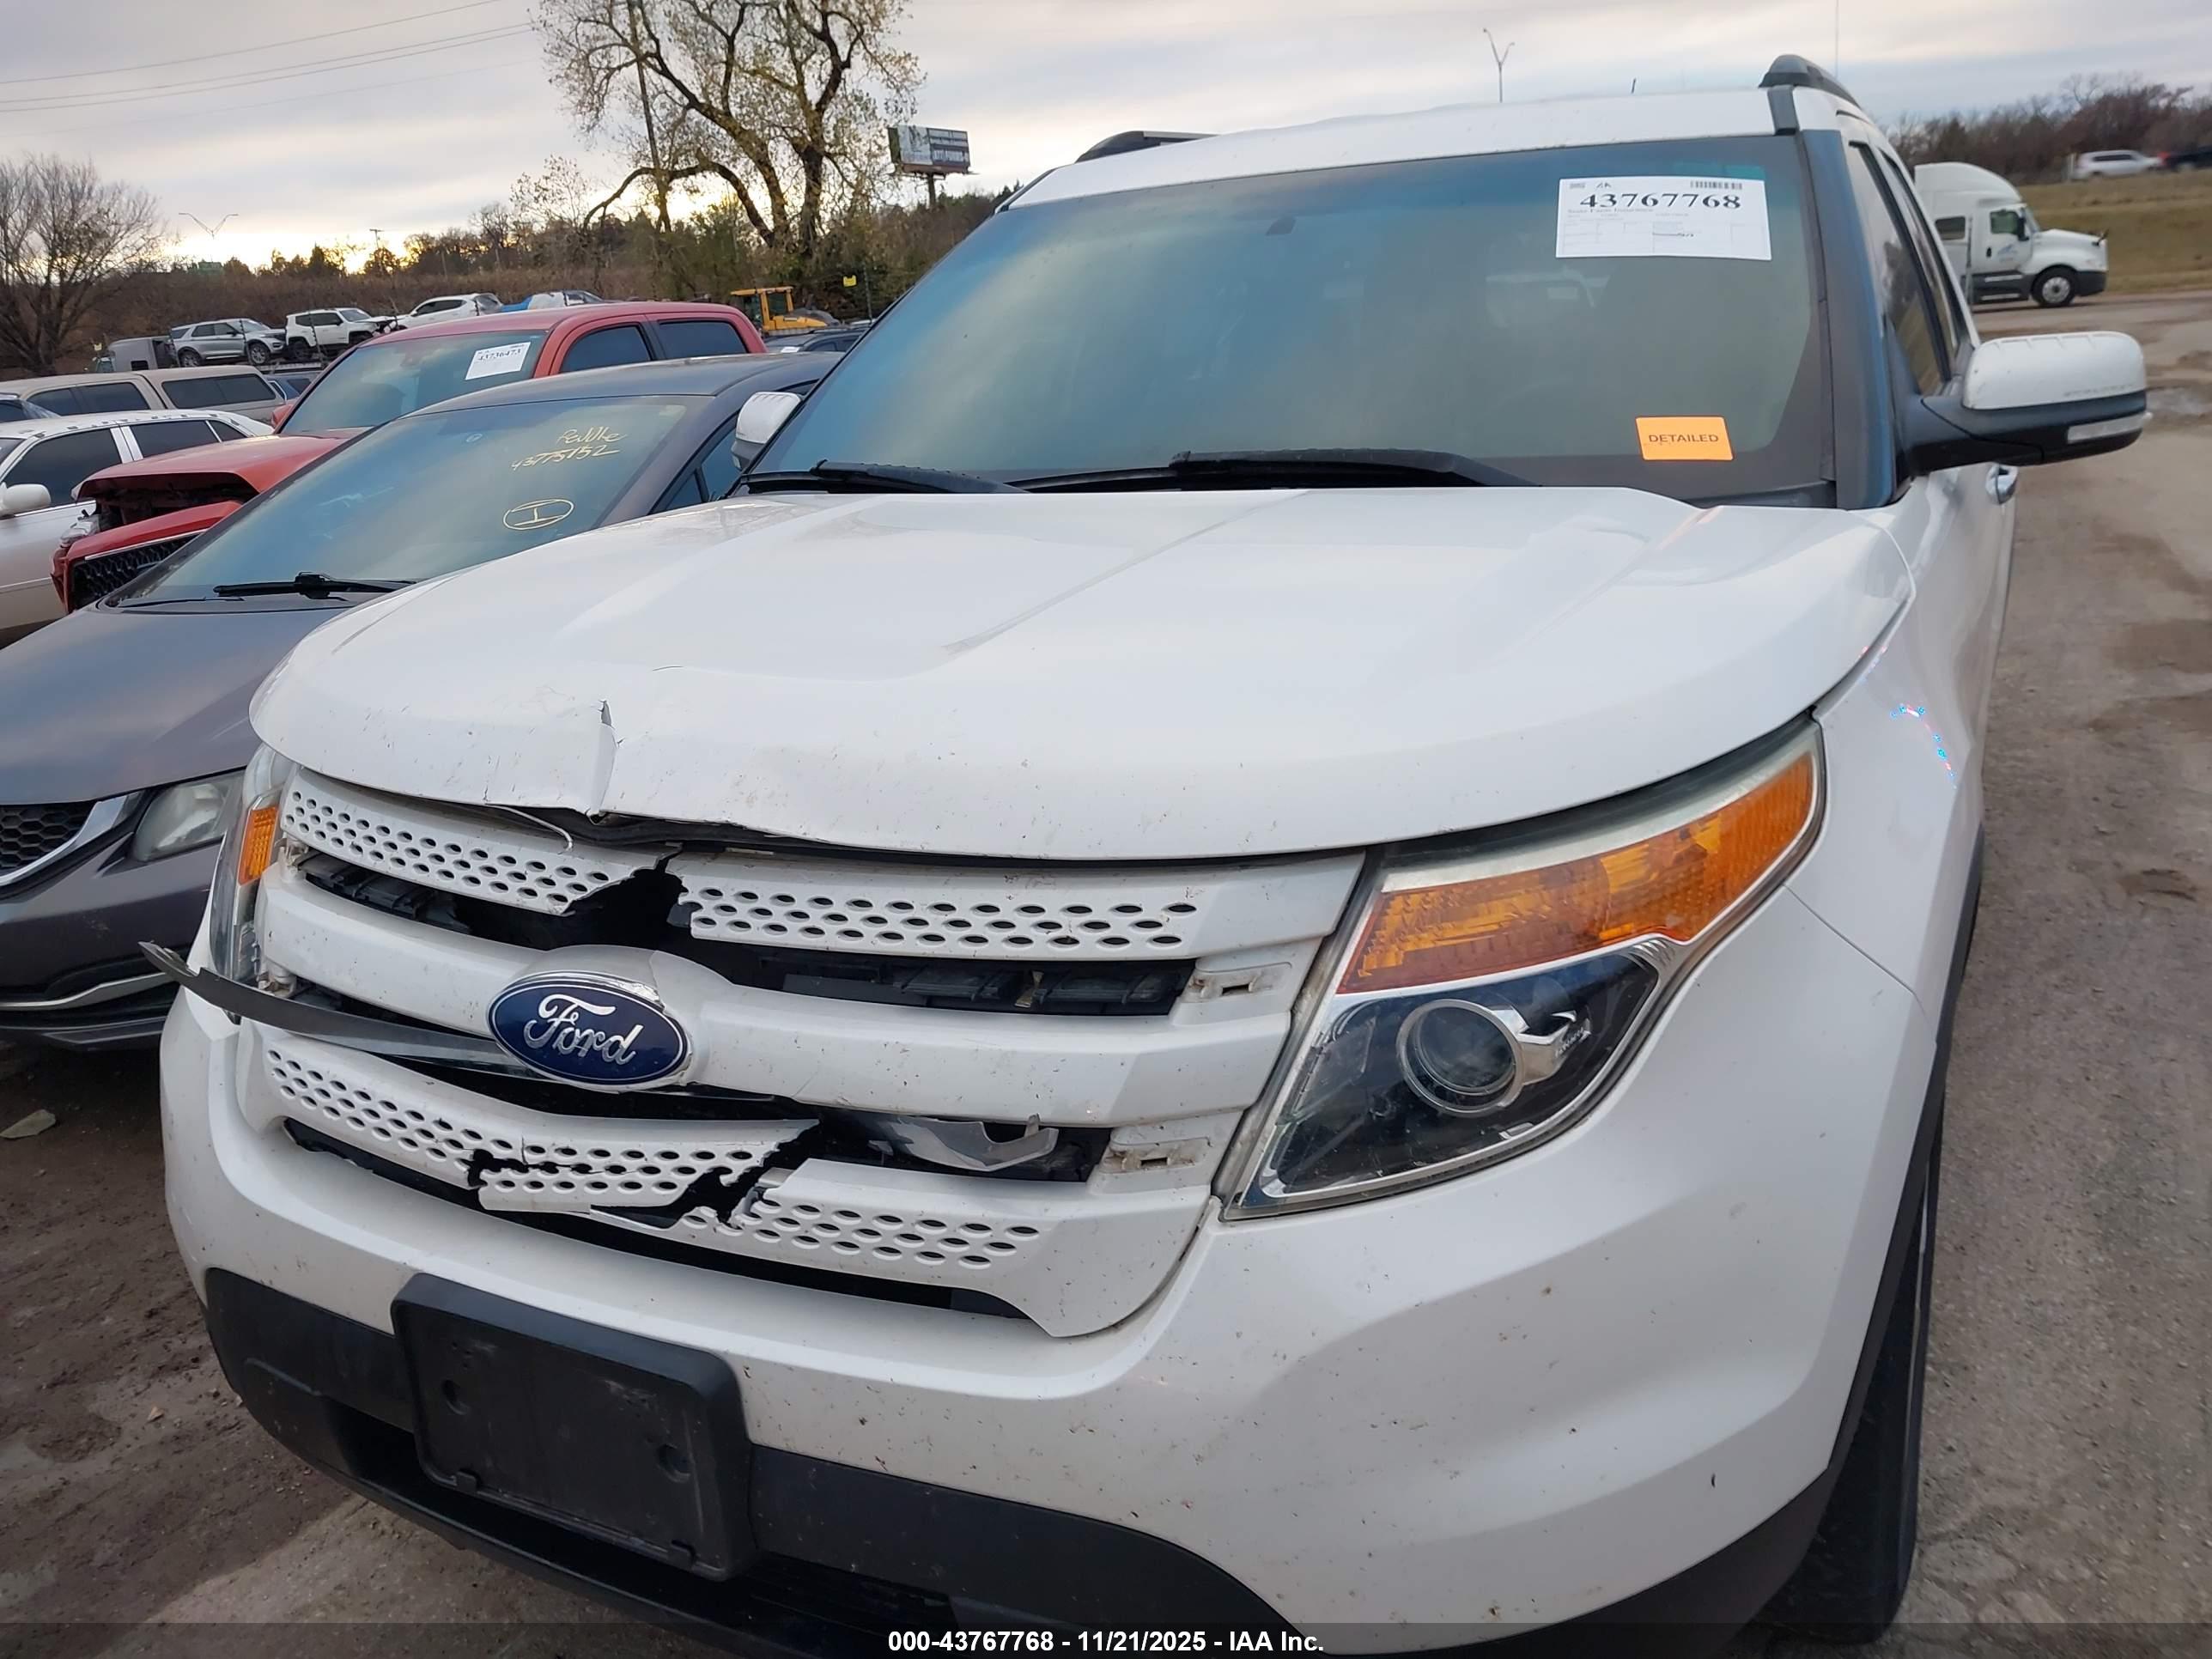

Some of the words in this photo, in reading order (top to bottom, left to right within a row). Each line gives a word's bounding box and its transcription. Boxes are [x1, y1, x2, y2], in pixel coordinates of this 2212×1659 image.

[1580, 192, 1741, 210] 43767768
[1648, 434, 1719, 442] DETAILED
[523, 994, 644, 1065] Ford
